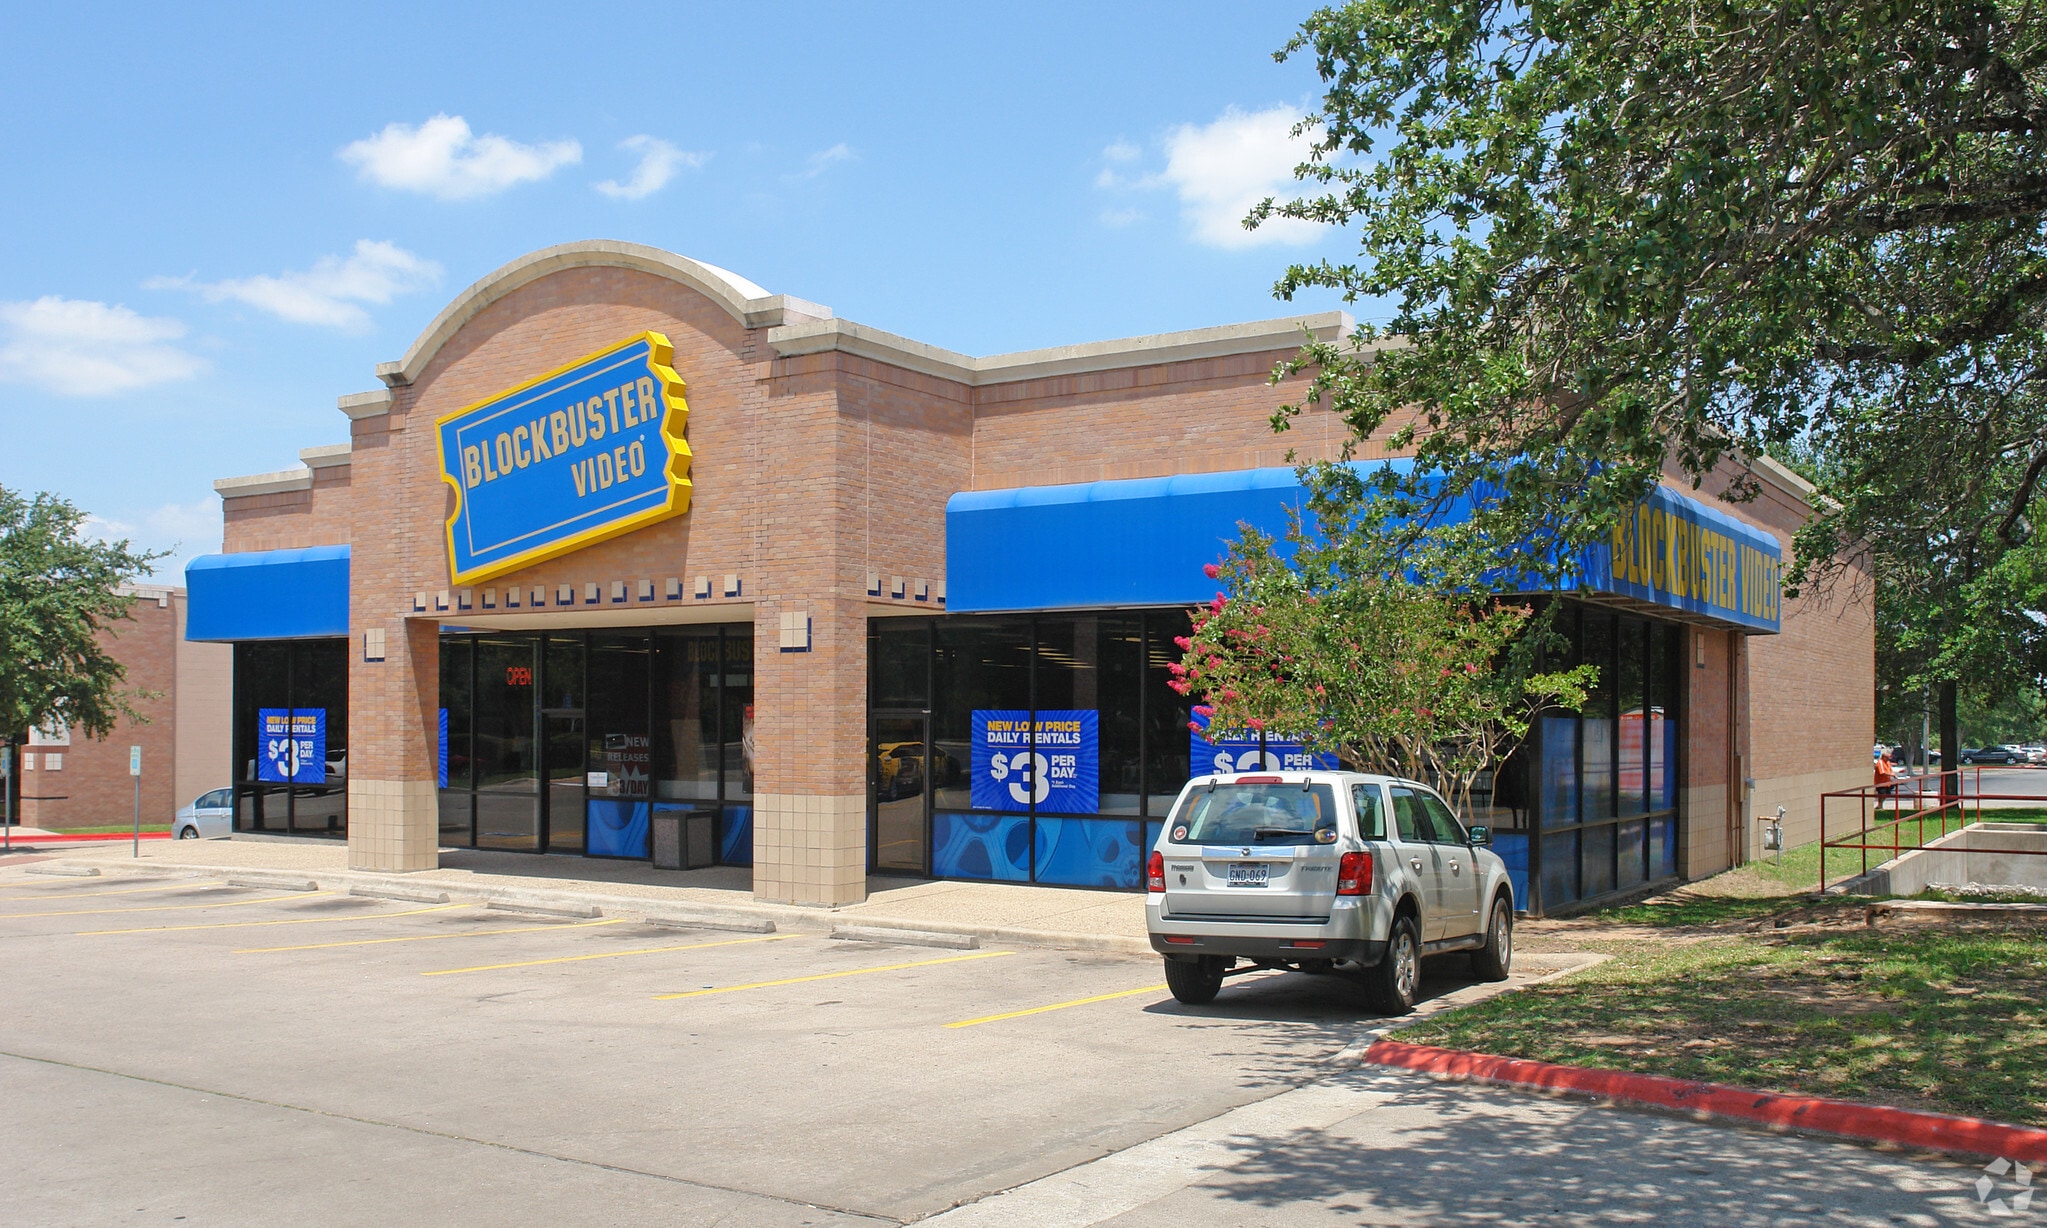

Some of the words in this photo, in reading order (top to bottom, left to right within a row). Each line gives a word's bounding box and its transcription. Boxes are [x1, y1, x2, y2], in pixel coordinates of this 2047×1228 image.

[464, 375, 658, 489] BLOCKBUSTER
[571, 440, 646, 498] VIDEO
[1612, 499, 1736, 611] BLOCKBUSTER
[1740, 543, 1779, 622] VIDEO
[506, 666, 532, 686] OPEN
[267, 716, 280, 724] NEW
[297, 716, 316, 724] PRICE
[267, 724, 284, 733] DAILY
[987, 721, 1013, 731] NEW
[1045, 721, 1081, 732] PRICE
[626, 736, 649, 747] NEW
[987, 732, 1020, 743] DAILY
[1023, 732, 1081, 744] RENTALS
[300, 741, 313, 749] PER
[268, 738, 300, 777] $3
[300, 749, 313, 758] DAY
[607, 753, 649, 762] RELEASES
[1051, 755, 1076, 767] PER
[1284, 754, 1313, 766] PER
[990, 751, 1050, 804] $3
